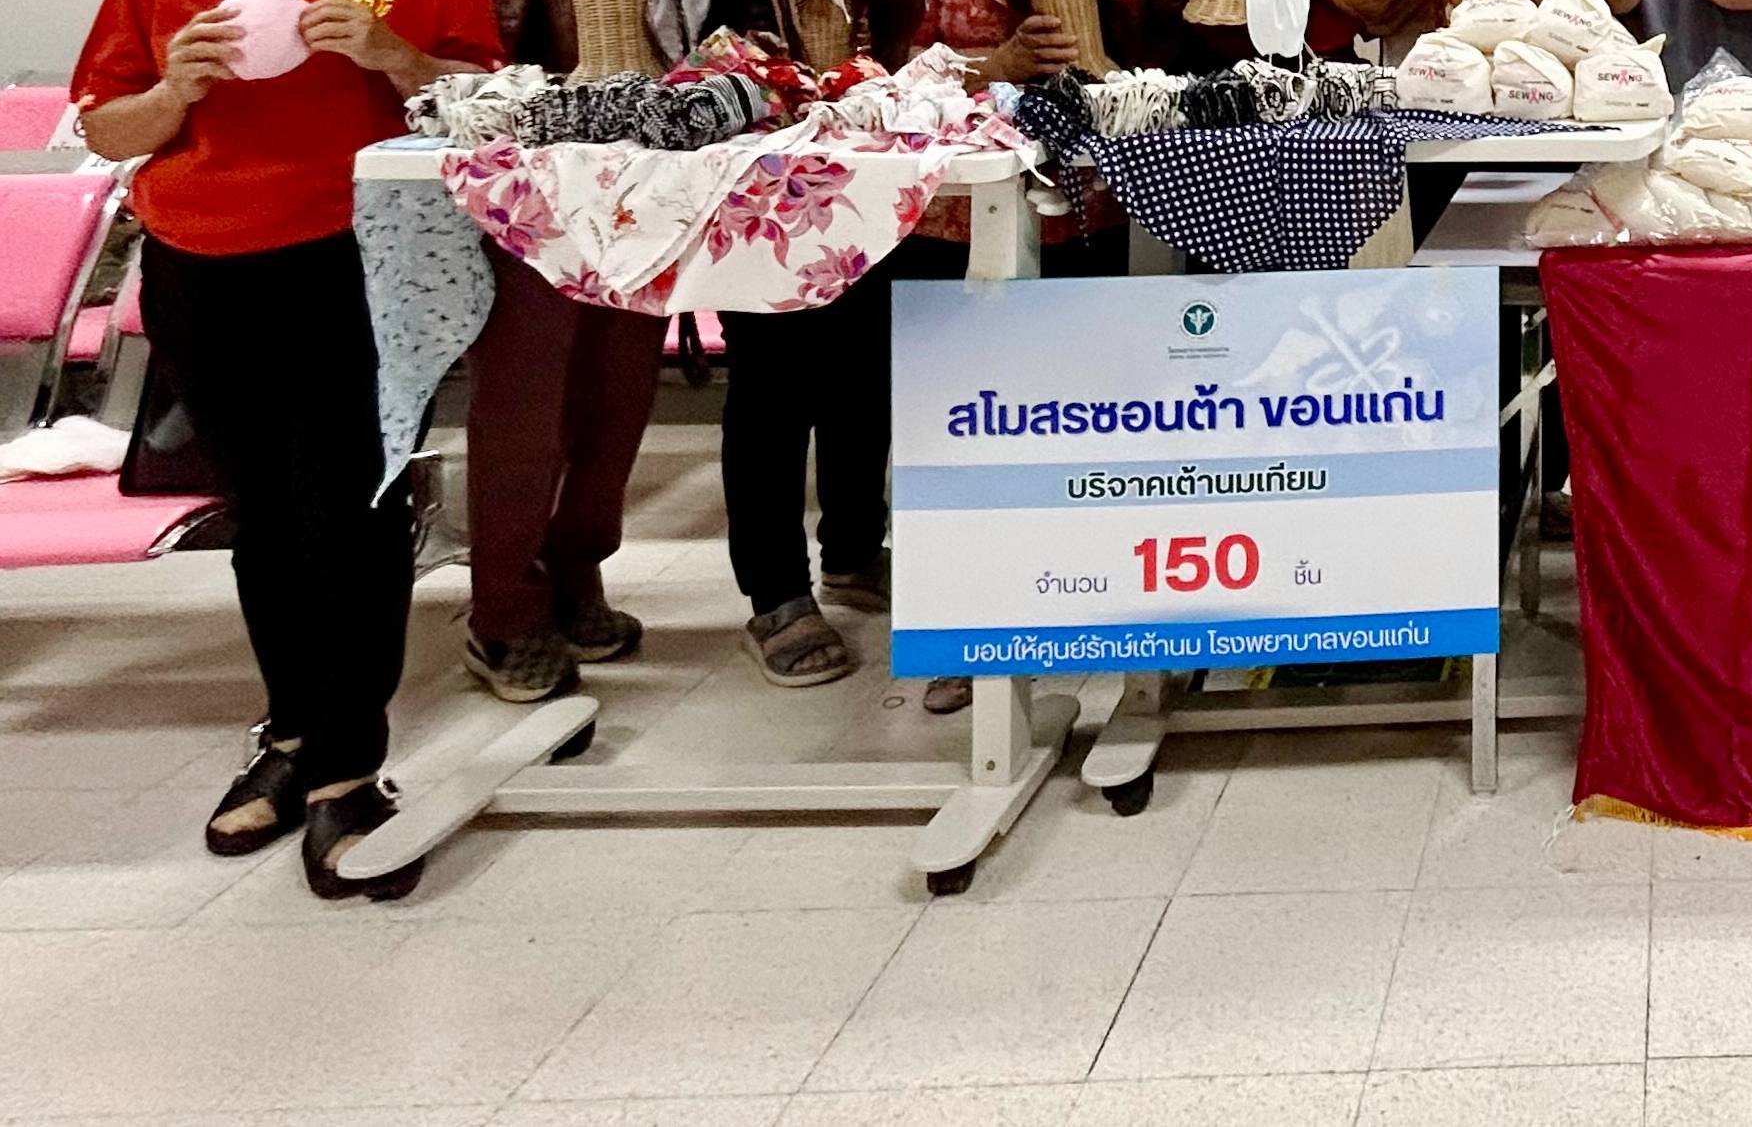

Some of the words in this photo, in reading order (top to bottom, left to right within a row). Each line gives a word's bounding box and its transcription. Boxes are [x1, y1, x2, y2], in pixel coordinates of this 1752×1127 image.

[947, 384, 1244, 438] สโมสรซอนต้า
[1258, 376, 1445, 430] ขอนแก่น
[1067, 461, 1327, 500] บริจาคเต้านมเทียม
[1036, 569, 1108, 596] จำนวน
[1132, 534, 1261, 594] 150
[1293, 559, 1323, 587] ชิ้น
[962, 628, 1201, 668] มอบให้ศูนย์รักษ์เต้านม
[1209, 621, 1430, 656] โรงพยาบาลขอนแก่น
